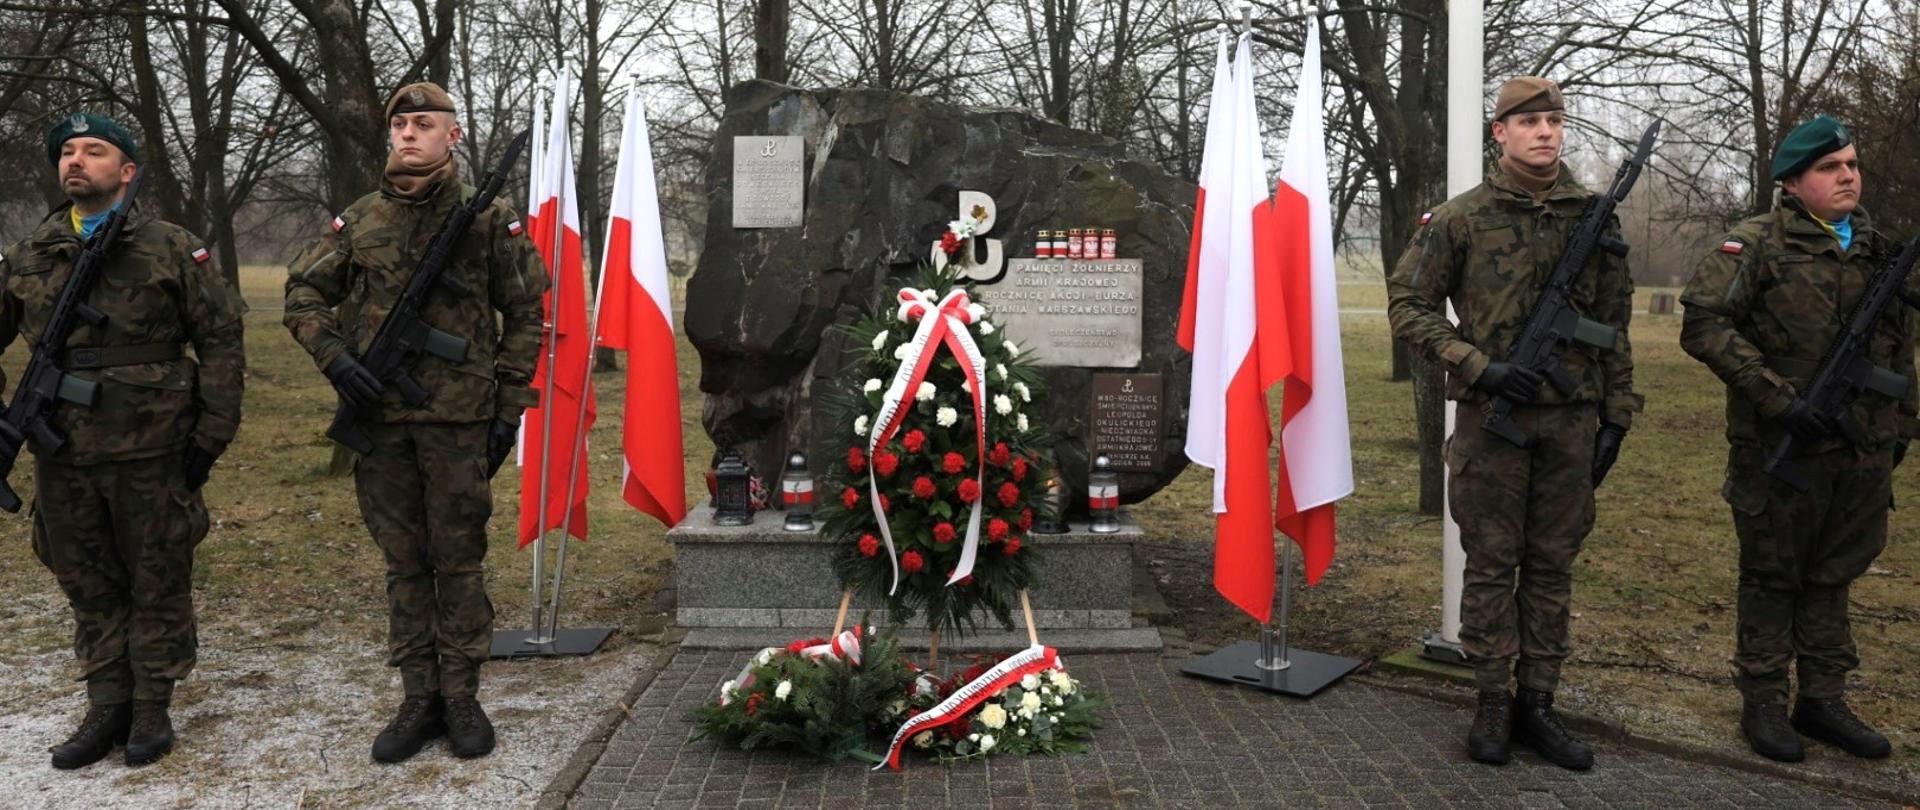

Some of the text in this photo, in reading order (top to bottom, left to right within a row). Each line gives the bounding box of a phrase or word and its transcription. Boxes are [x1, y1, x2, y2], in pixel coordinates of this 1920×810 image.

[1016, 262, 1138, 273] PAMIĘCI ŻOŁNIERZY
[1016, 277, 1118, 287] ARMII KRAJOWEJ
[985, 290, 1043, 301] ROCZNICĘ
[1050, 291, 1086, 300] AKCJI
[1038, 304, 1137, 314] WARSZAWSKIEGO
[1106, 411, 1147, 419] LEOPOLDA
[1096, 418, 1157, 428] OKULICKIEGO
